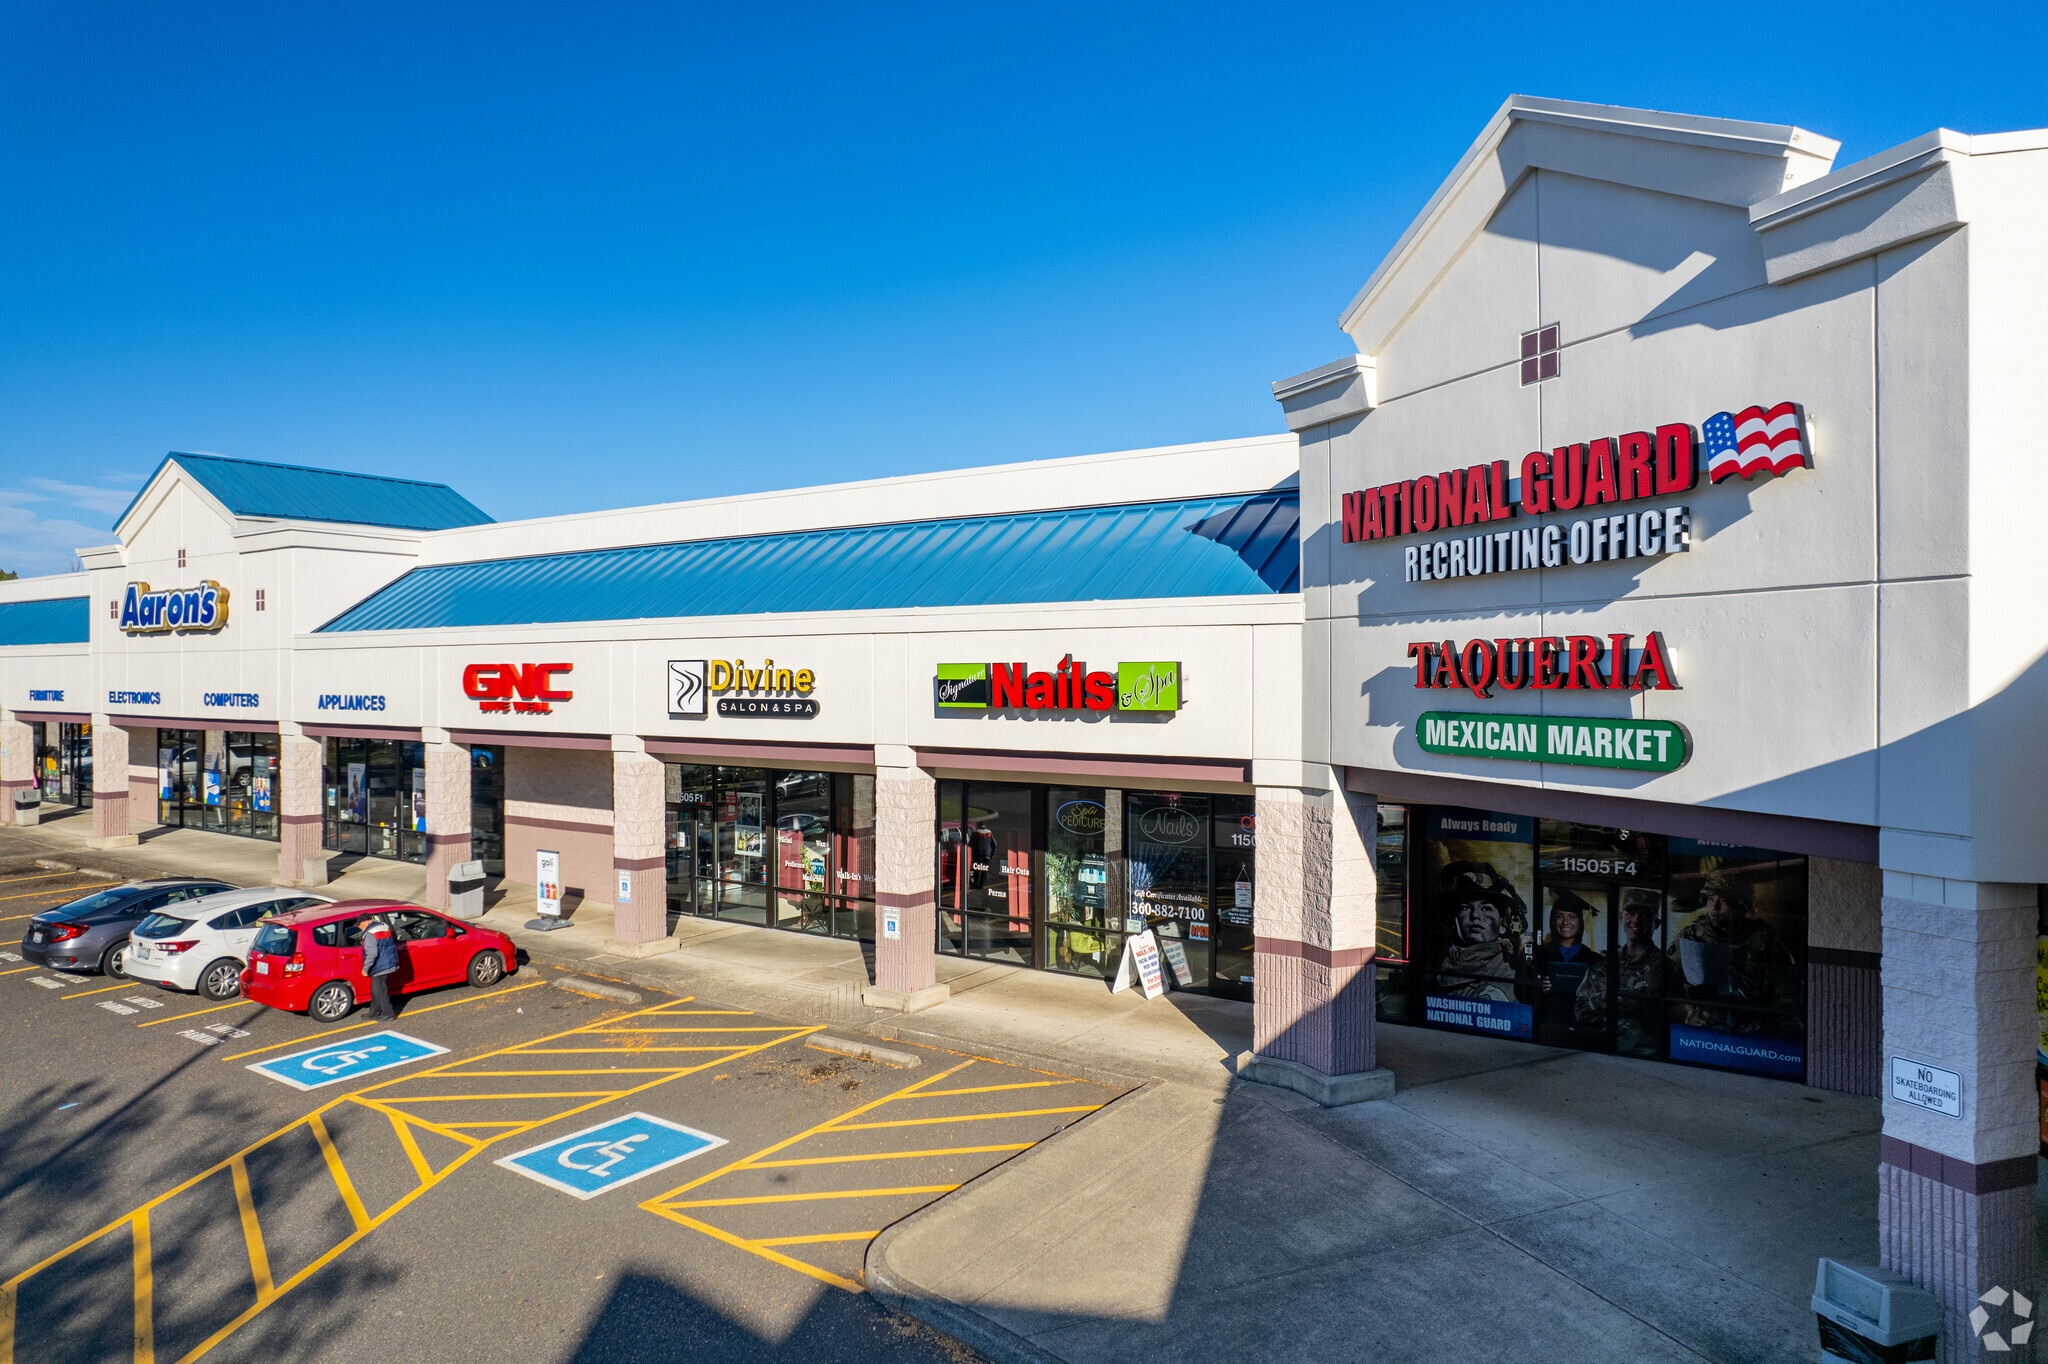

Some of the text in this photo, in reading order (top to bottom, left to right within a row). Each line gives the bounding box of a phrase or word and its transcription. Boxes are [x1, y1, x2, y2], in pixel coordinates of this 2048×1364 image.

[1342, 423, 1695, 544] NATIONAL GUARD
[1405, 506, 1685, 582] RECRUITING OFFICE
[120, 583, 218, 629] Aaron's
[1407, 631, 1682, 699] TAQUERIA
[463, 663, 573, 699] GNC
[711, 658, 814, 692] Divine
[939, 655, 1176, 711] Signature Nails & Spa
[29, 690, 64, 701] FURNITURE
[109, 691, 161, 704] ELECTRONICS
[204, 693, 259, 707] COMPUTERS
[318, 695, 386, 711] APPLIANCES
[1425, 719, 1672, 762] MEXICAN MARKET
[1071, 803, 1098, 818] Spa
[1061, 816, 1105, 829] PEDICURE
[1145, 812, 1193, 837] Nails
[1441, 818, 1517, 834] Always Ready
[973, 862, 989, 871] Color
[1001, 865, 1030, 876] Hair Cuts
[1561, 858, 1637, 876] 11505 F4
[988, 888, 1006, 898] Perms
[1134, 889, 1203, 902] Gift Certificates Available
[1131, 901, 1205, 920] 360-882-7100
[1426, 996, 1491, 1015] WASHINGTON
[1427, 1009, 1511, 1031] NATIONAL GUARD
[1680, 1038, 1801, 1063] NATIONALGUARD.com
[1917, 1068, 1933, 1083] NO
[1895, 1076, 1957, 1101] SKATEBOARDING
[1909, 1091, 1943, 1107] ALLOWED
